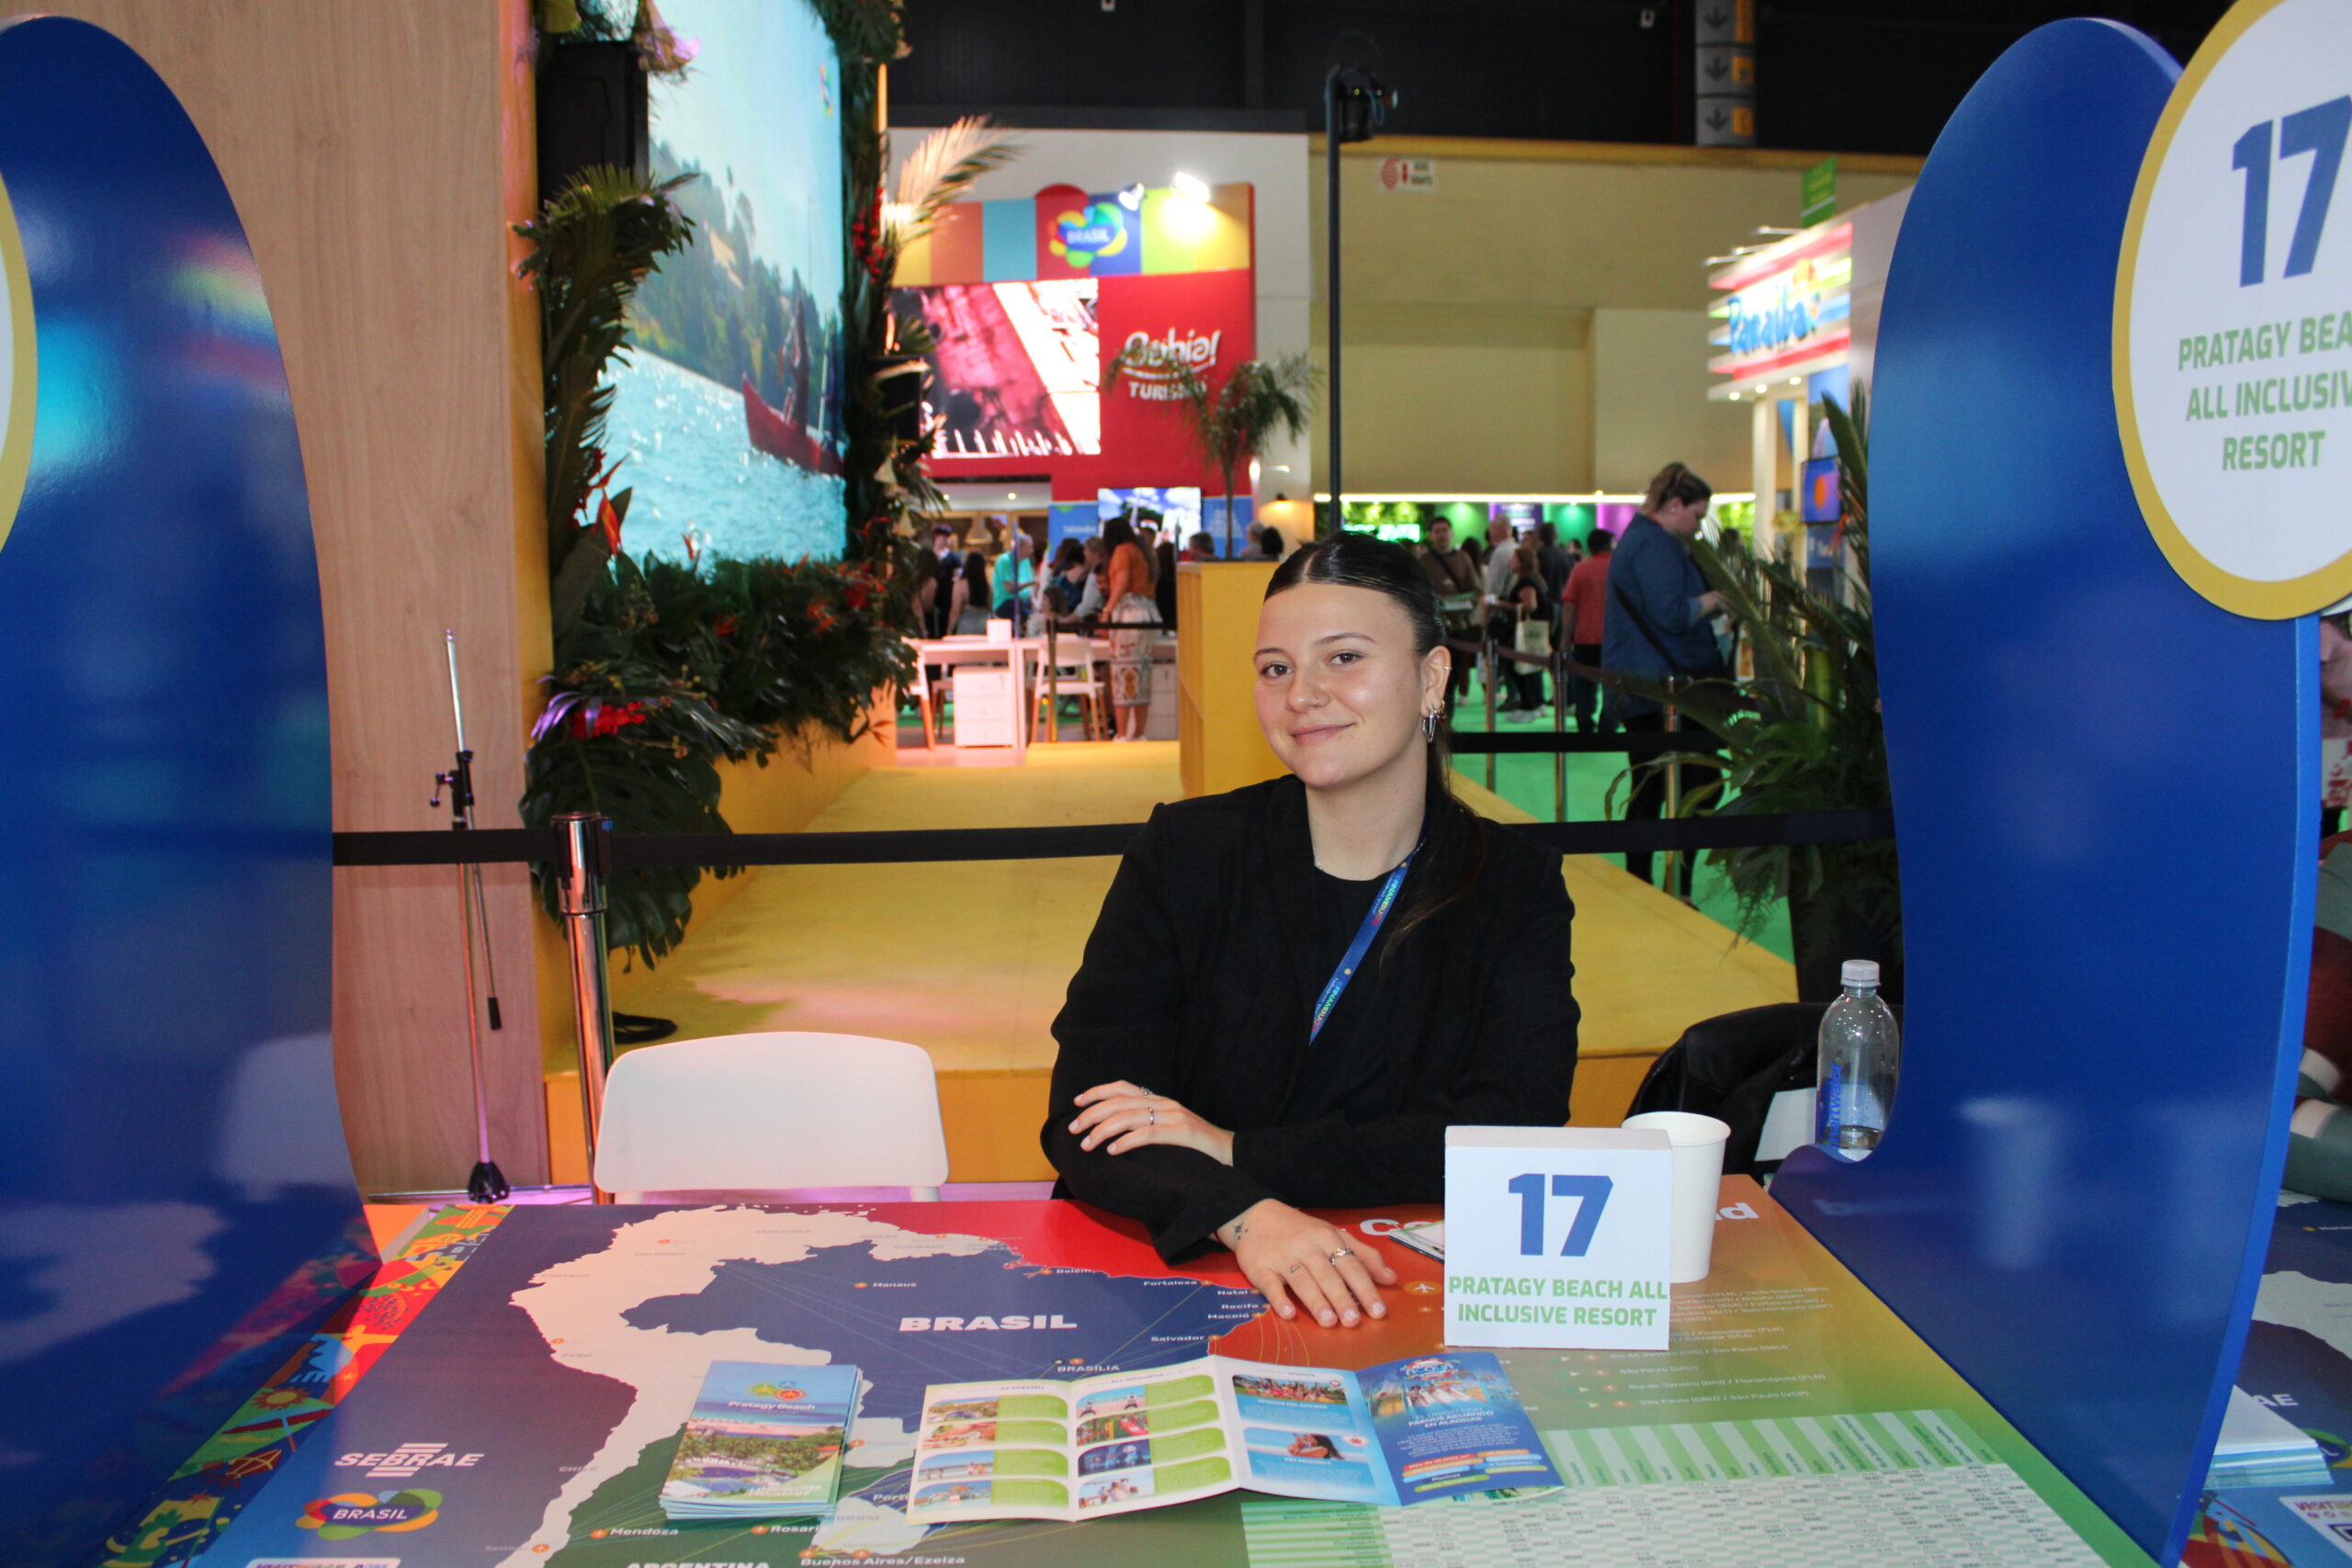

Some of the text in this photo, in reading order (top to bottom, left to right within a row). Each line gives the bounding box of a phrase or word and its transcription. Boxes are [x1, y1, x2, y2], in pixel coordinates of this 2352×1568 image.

[2232, 94, 2352, 288] 17
[1067, 228, 1110, 244] BRASIL
[2178, 321, 2292, 371] PRATAGY
[2186, 385, 2229, 422] ALL
[2222, 430, 2326, 471] RESORT
[1508, 1173, 1614, 1258] 17
[1449, 1276, 1668, 1300] PRATAGY BEACH ALL
[899, 1314, 1078, 1332] BRASIL
[1458, 1303, 1567, 1325] INCLUSIVE
[1574, 1306, 1657, 1326] RESORT
[1057, 1362, 1120, 1373] BRASÍLIA
[334, 1452, 484, 1467] SEBRAE
[333, 1508, 408, 1520] BRASIL
[610, 1528, 679, 1537] Mendoza
[800, 1555, 965, 1567] Buenos Aires/Ezeiza
